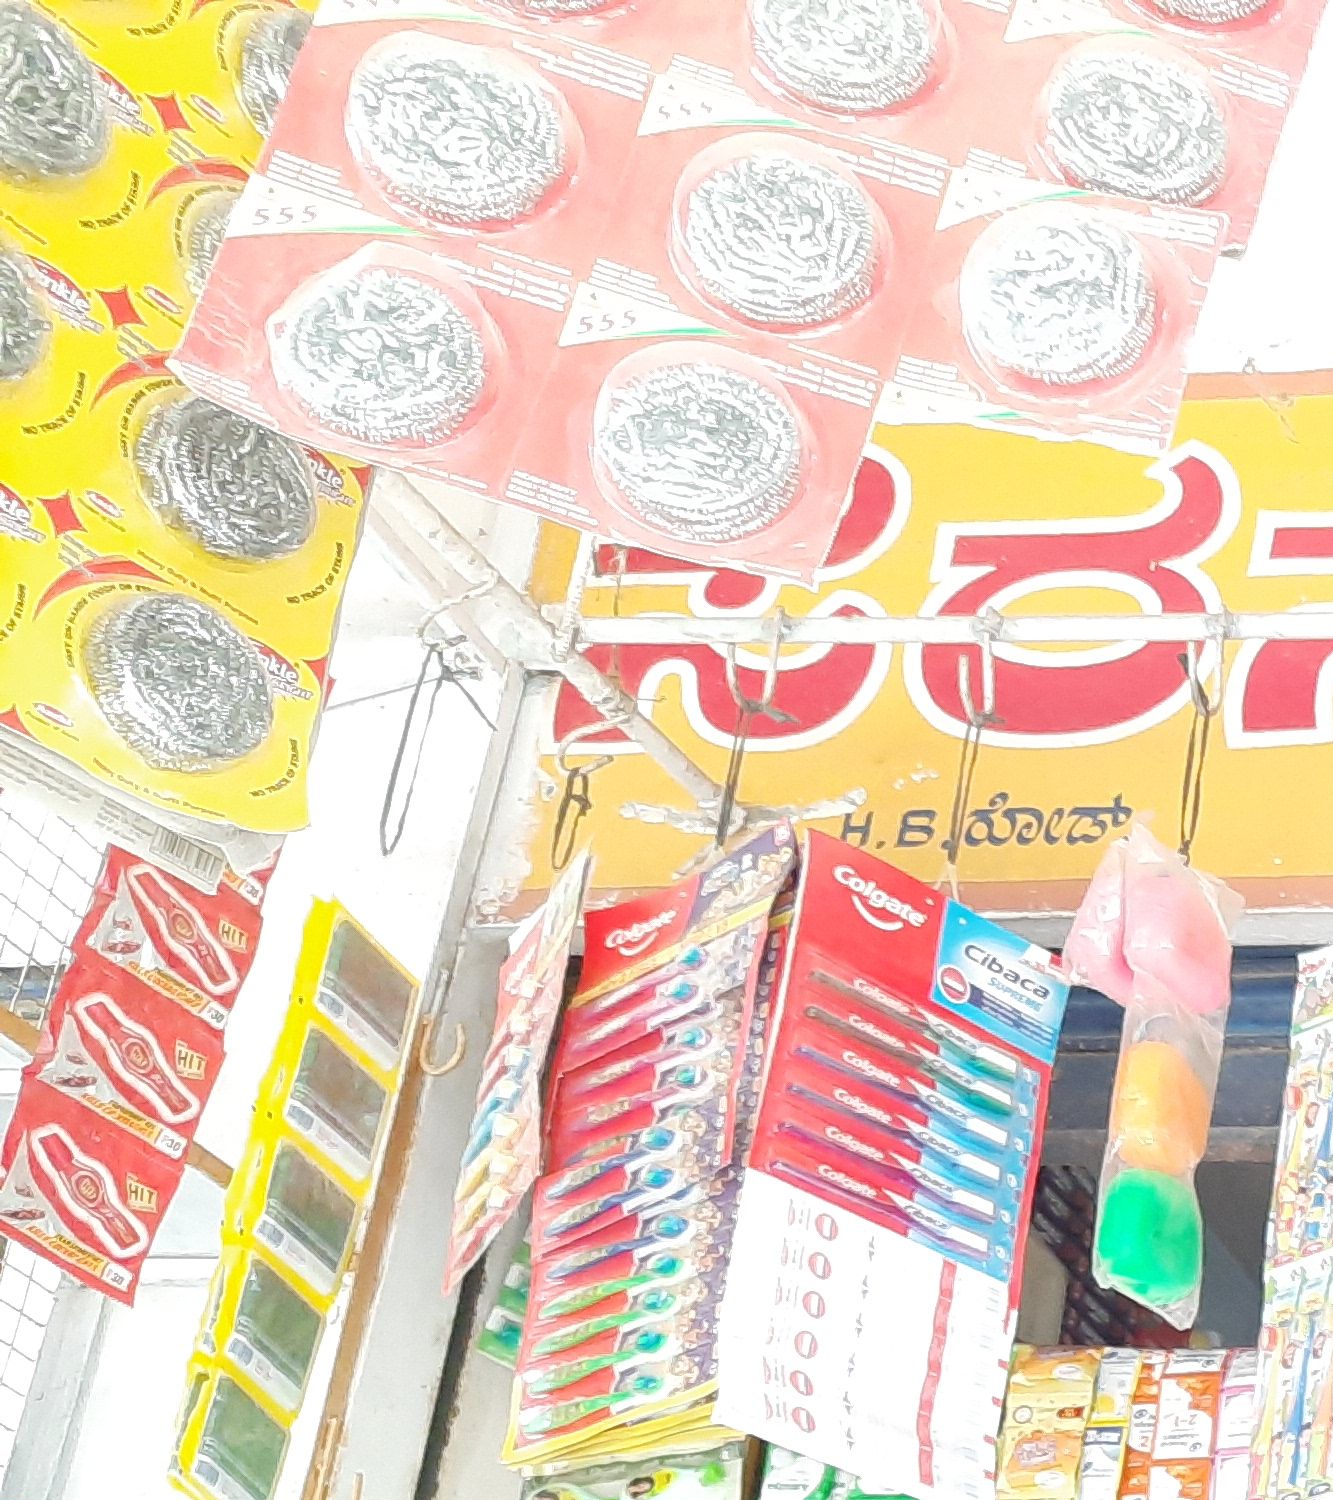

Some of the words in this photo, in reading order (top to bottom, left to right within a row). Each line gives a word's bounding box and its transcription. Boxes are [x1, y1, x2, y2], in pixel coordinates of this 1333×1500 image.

[834, 864, 928, 928] Colgate
[221, 922, 247, 947] HIT
[965, 943, 1051, 1000] Cibaca
[178, 1050, 205, 1071] HIT
[842, 1050, 901, 1087] Colgate
[129, 1184, 156, 1206] HIT
